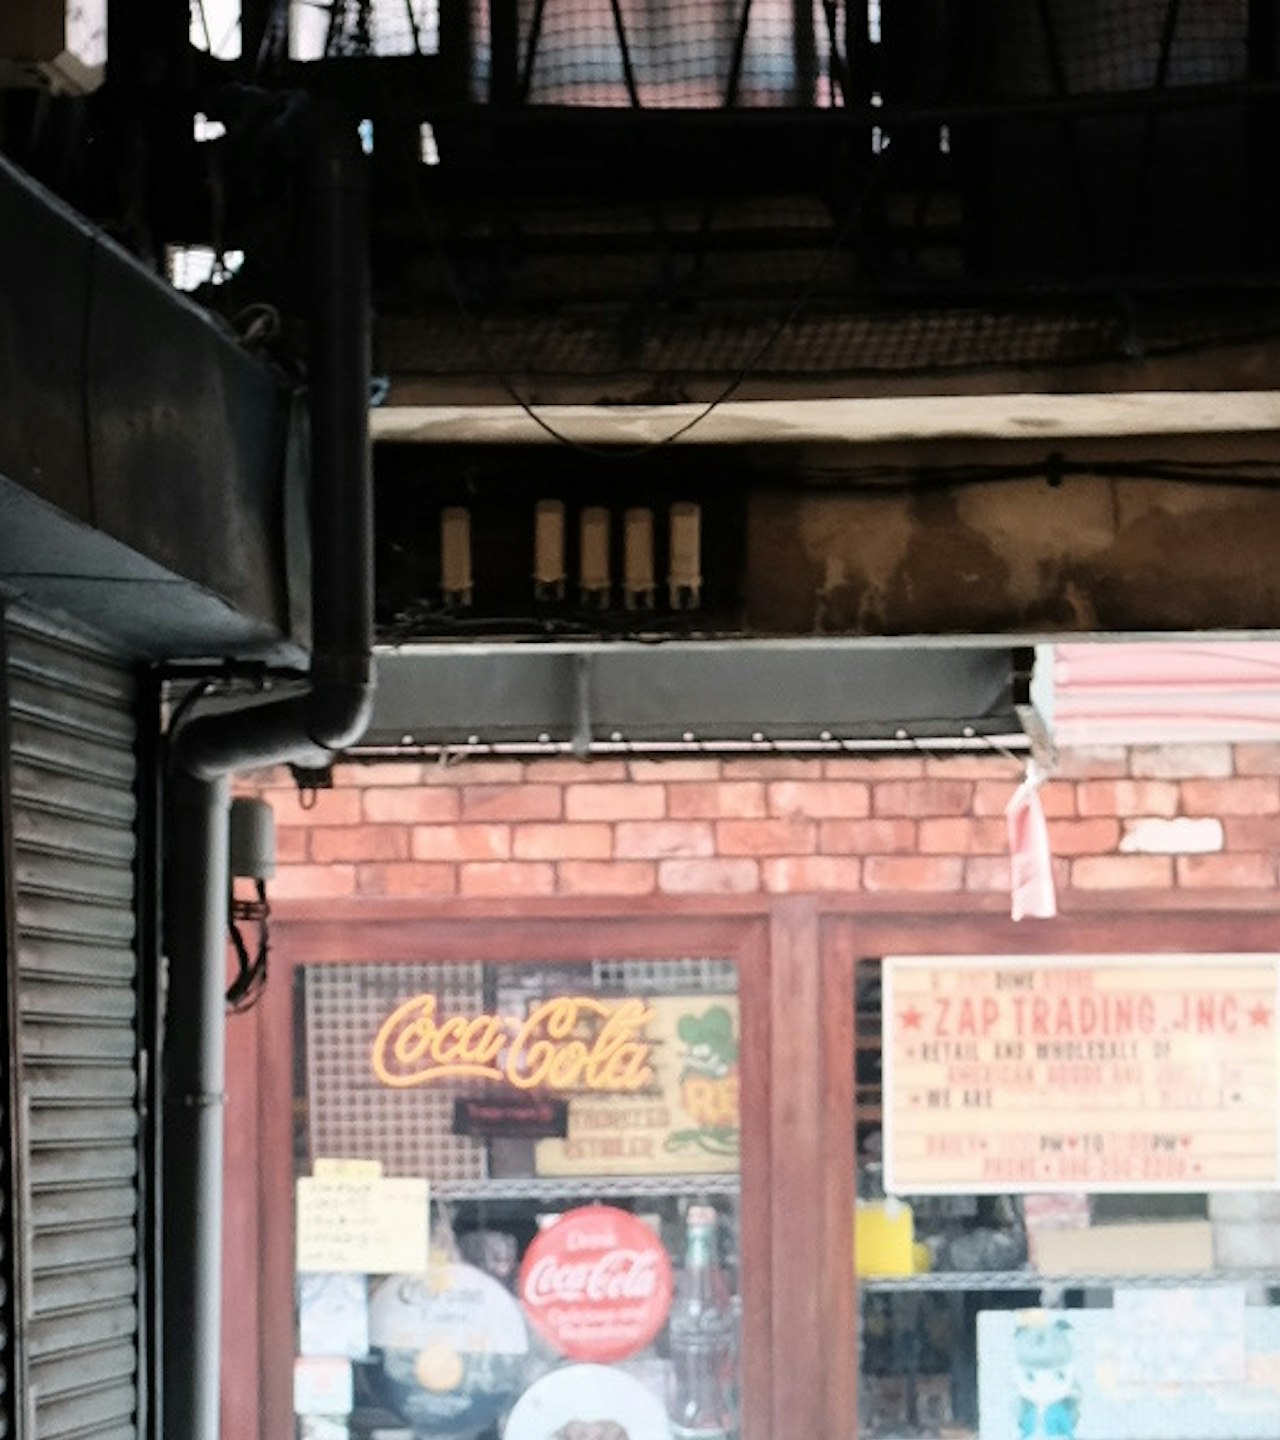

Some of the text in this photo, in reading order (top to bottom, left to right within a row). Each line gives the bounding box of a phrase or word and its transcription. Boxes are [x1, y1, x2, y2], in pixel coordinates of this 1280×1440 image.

[934, 997, 999, 1037] ZAP
[922, 1041, 978, 1061] RETAIL
[994, 1041, 1024, 1060] AND
[1035, 1040, 1138, 1061] WHOLESALE
[962, 1088, 995, 1108] ARE
